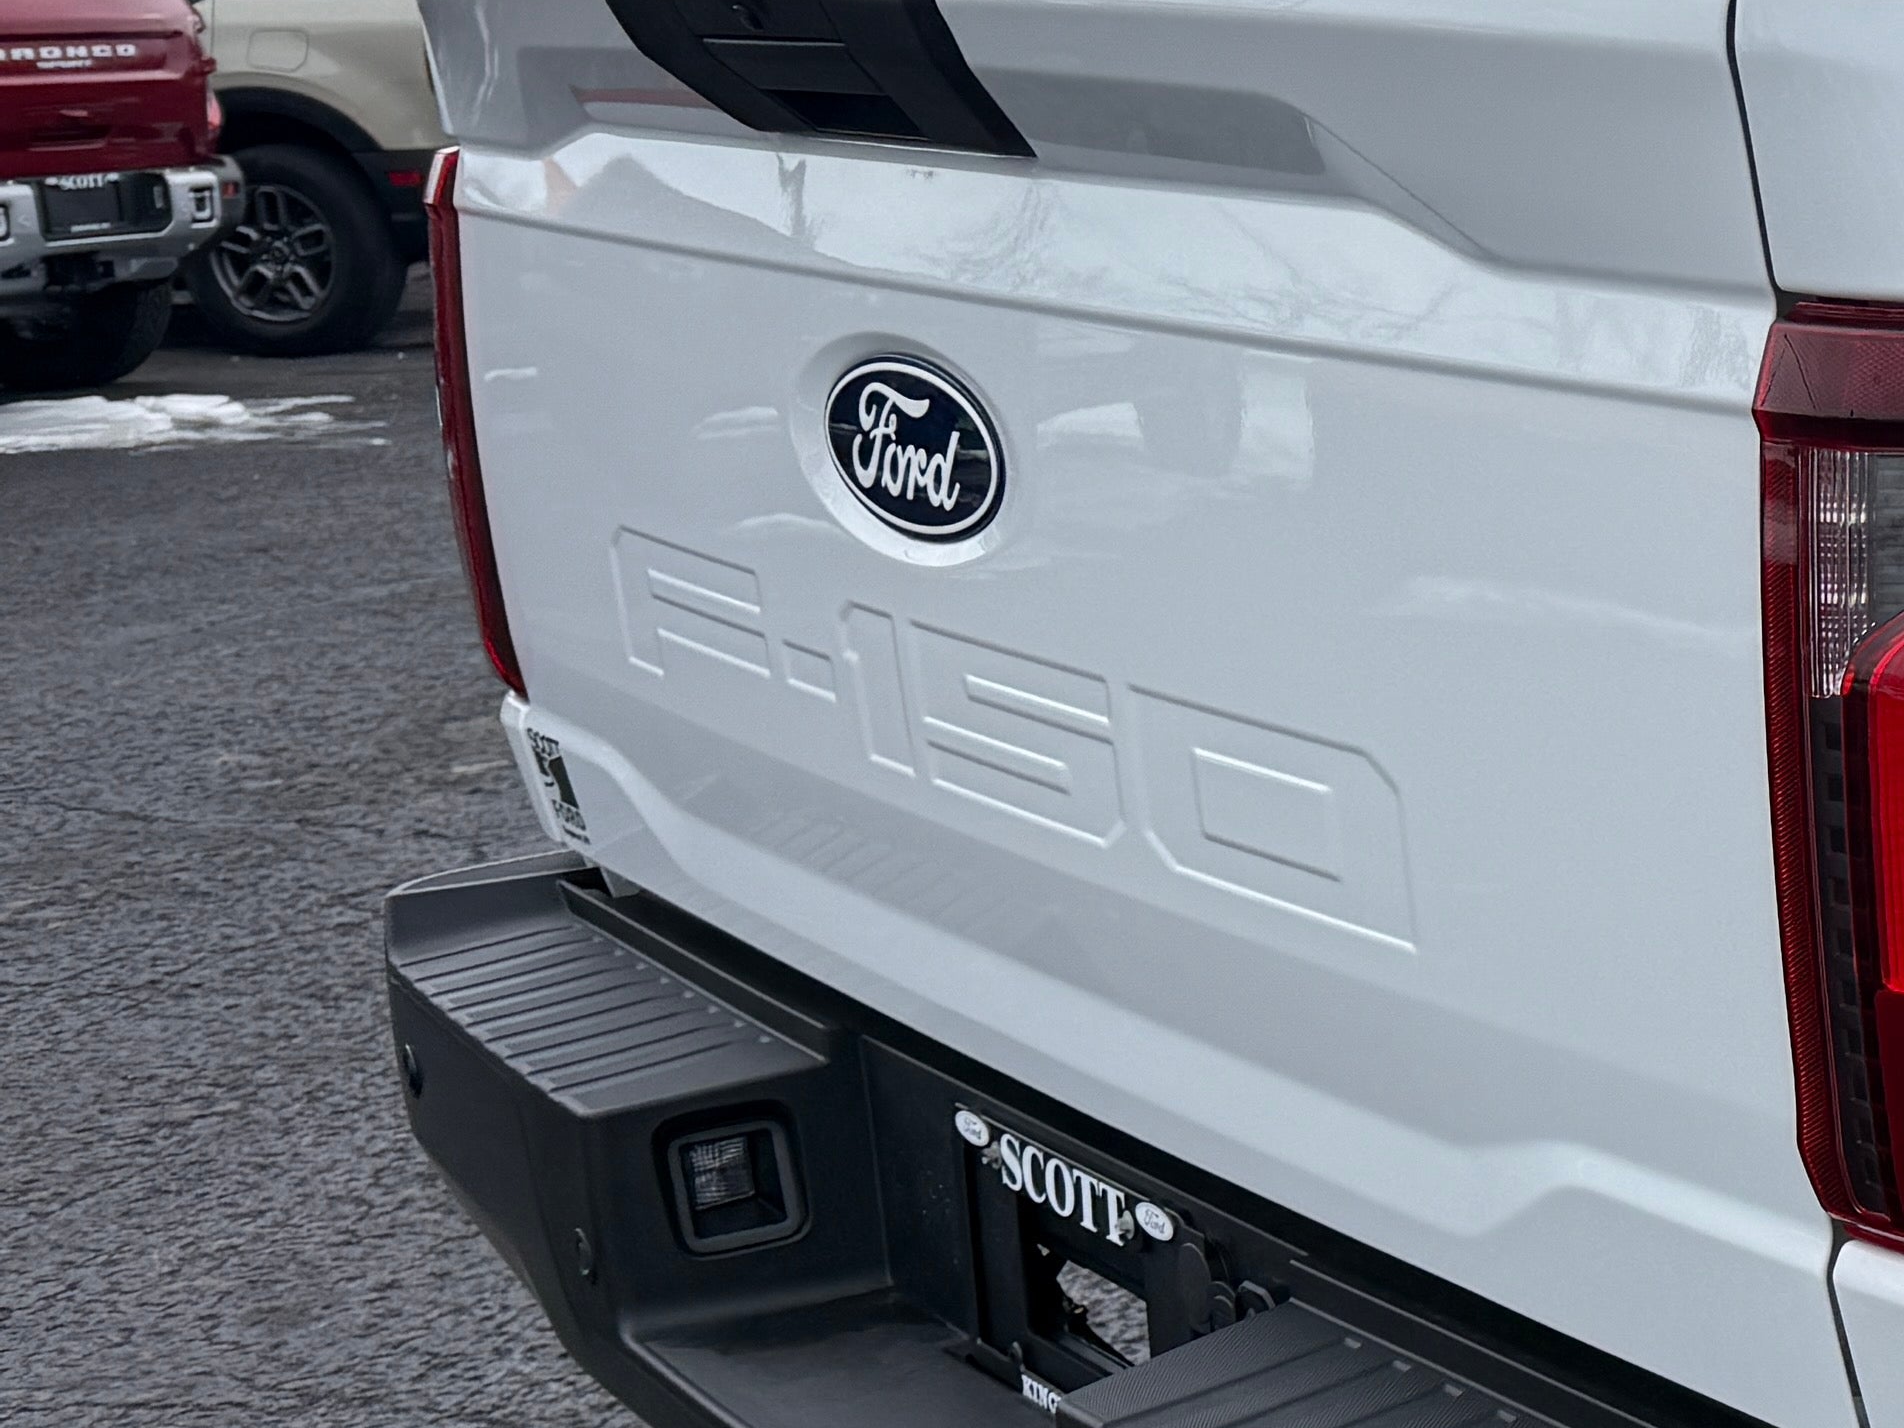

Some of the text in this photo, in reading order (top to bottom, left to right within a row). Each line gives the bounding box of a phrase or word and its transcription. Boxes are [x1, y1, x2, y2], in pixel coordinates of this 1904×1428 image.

[852, 382, 961, 512] Ford
[611, 523, 1417, 955] F-150
[1000, 1133, 1126, 1247] SCOTT
